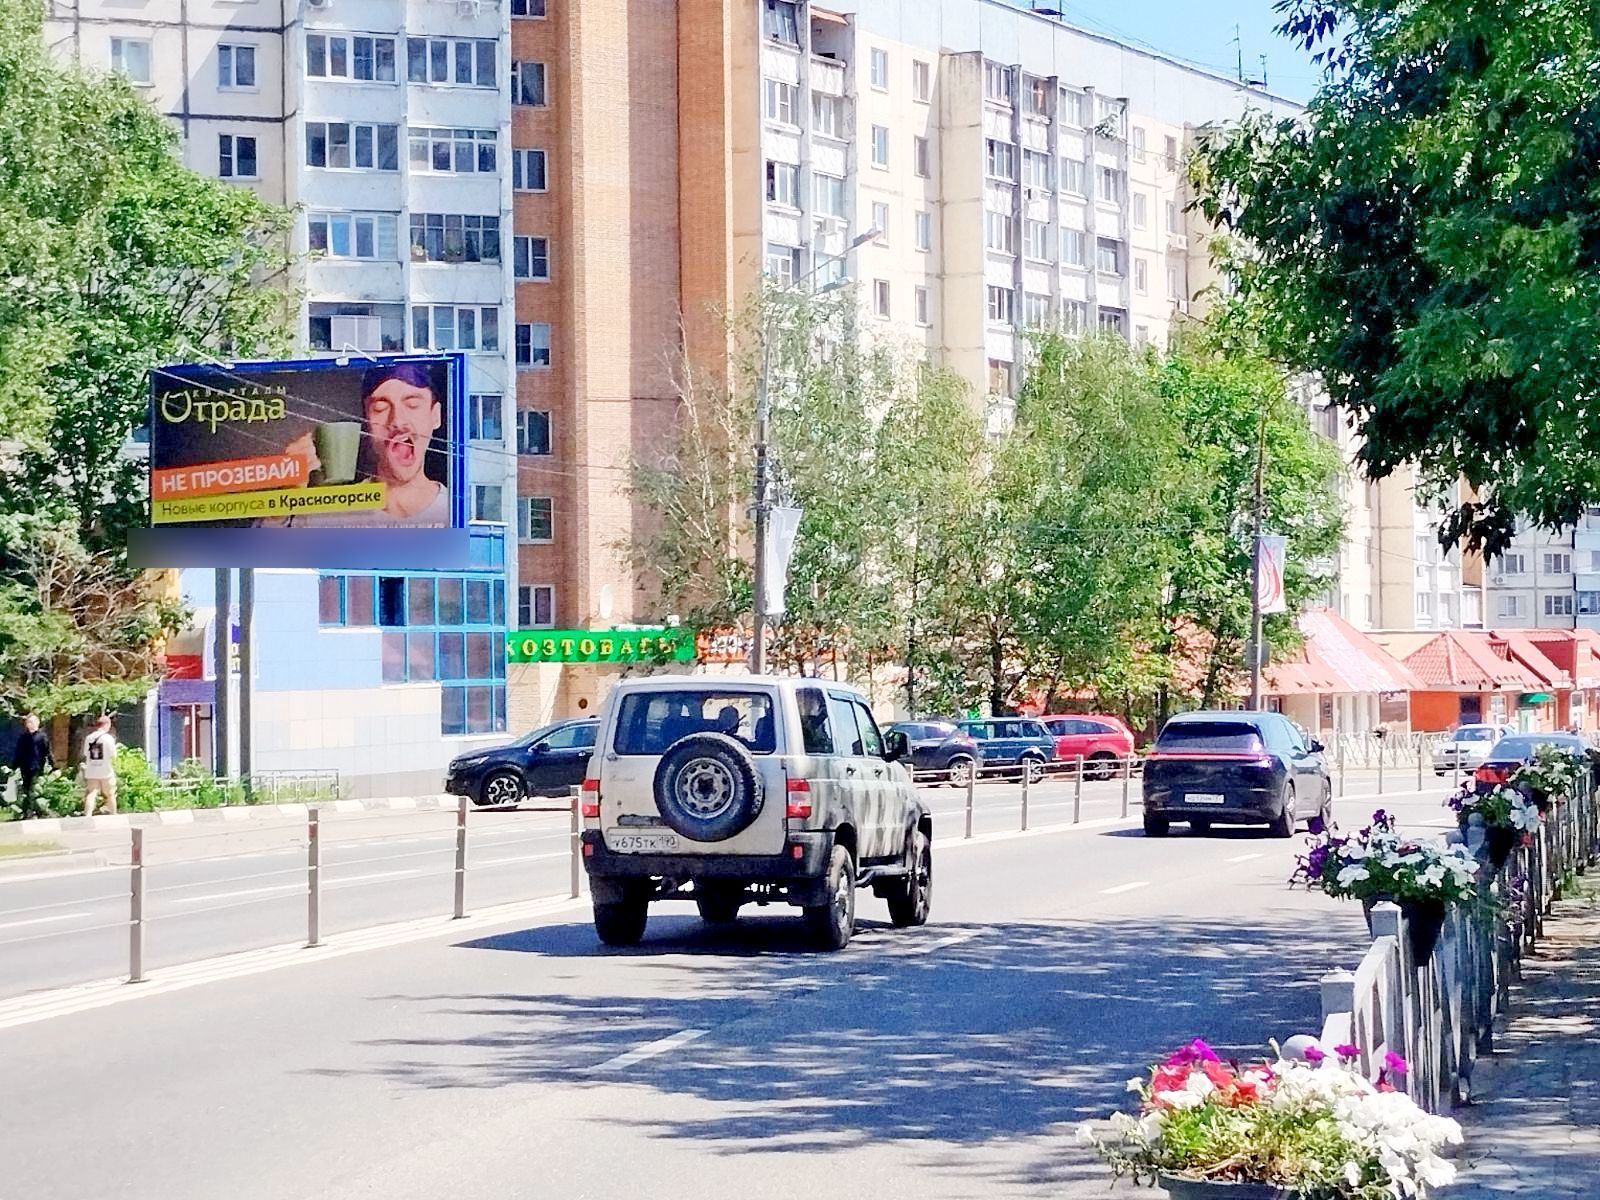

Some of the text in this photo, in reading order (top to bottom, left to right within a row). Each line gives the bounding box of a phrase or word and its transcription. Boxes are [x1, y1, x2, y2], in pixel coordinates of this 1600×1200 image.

[161, 390, 287, 434] Отрада
[161, 457, 300, 493] НЕ ПРОЗЕВАЙ!
[162, 490, 382, 516] Новые корпуса в Красногорске
